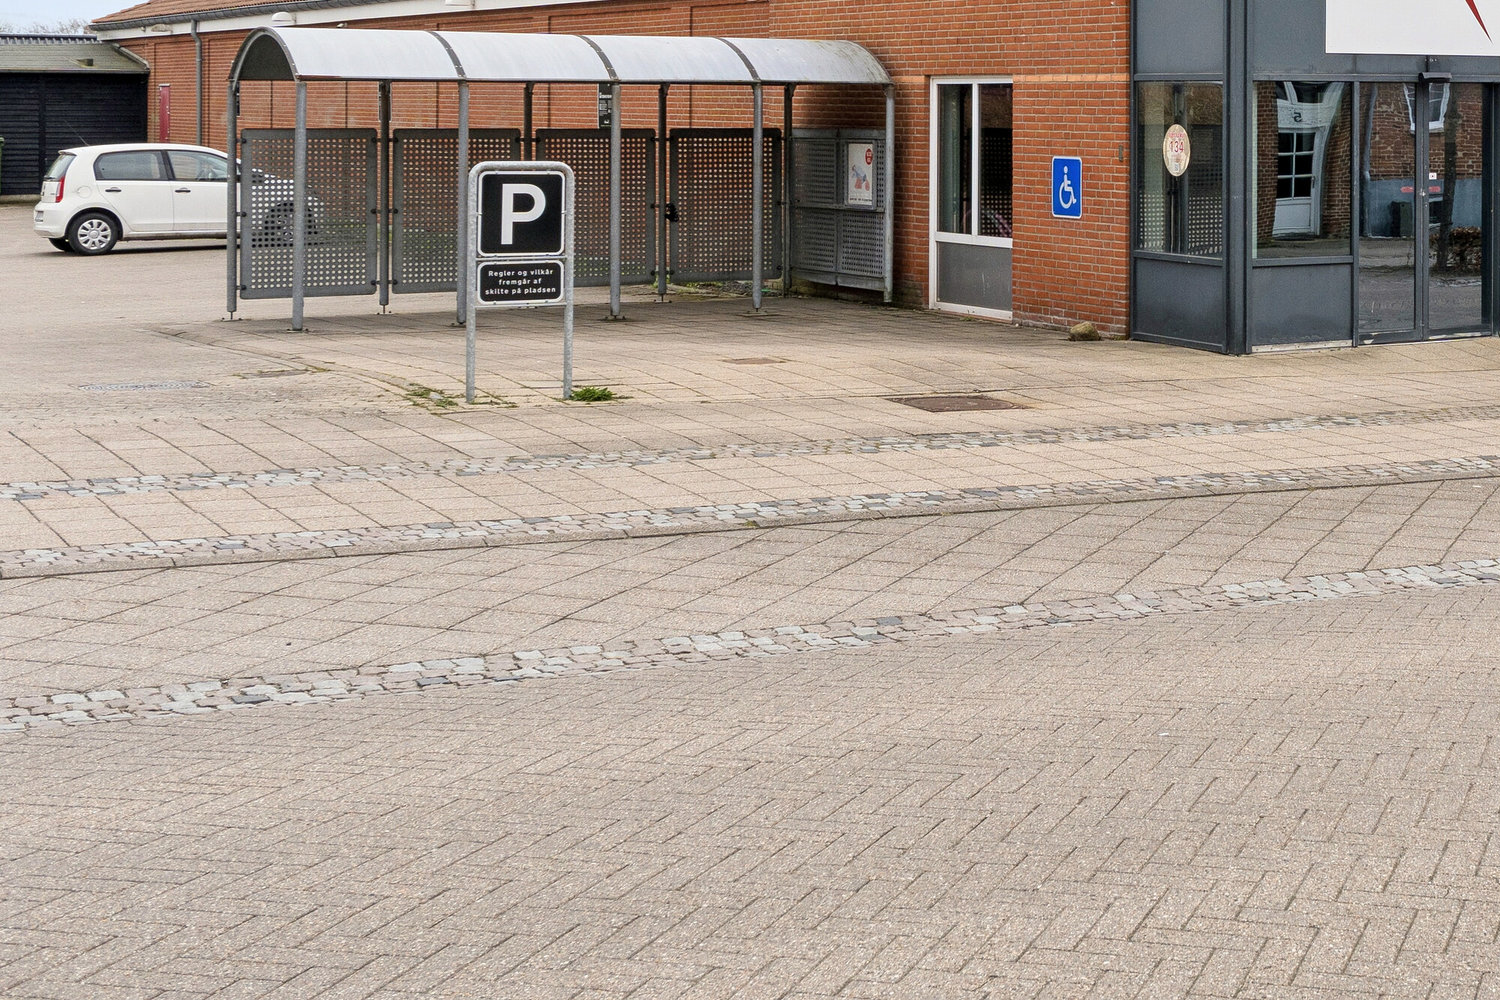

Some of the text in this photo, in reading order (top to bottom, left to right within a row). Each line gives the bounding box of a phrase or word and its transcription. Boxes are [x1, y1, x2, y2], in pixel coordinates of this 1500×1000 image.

[1170, 141, 1184, 152] 134
[501, 183, 546, 245] P
[488, 270, 515, 278] Regler
[498, 278, 531, 286] fremgår
[511, 287, 522, 295] på
[524, 287, 556, 295] pladsen
